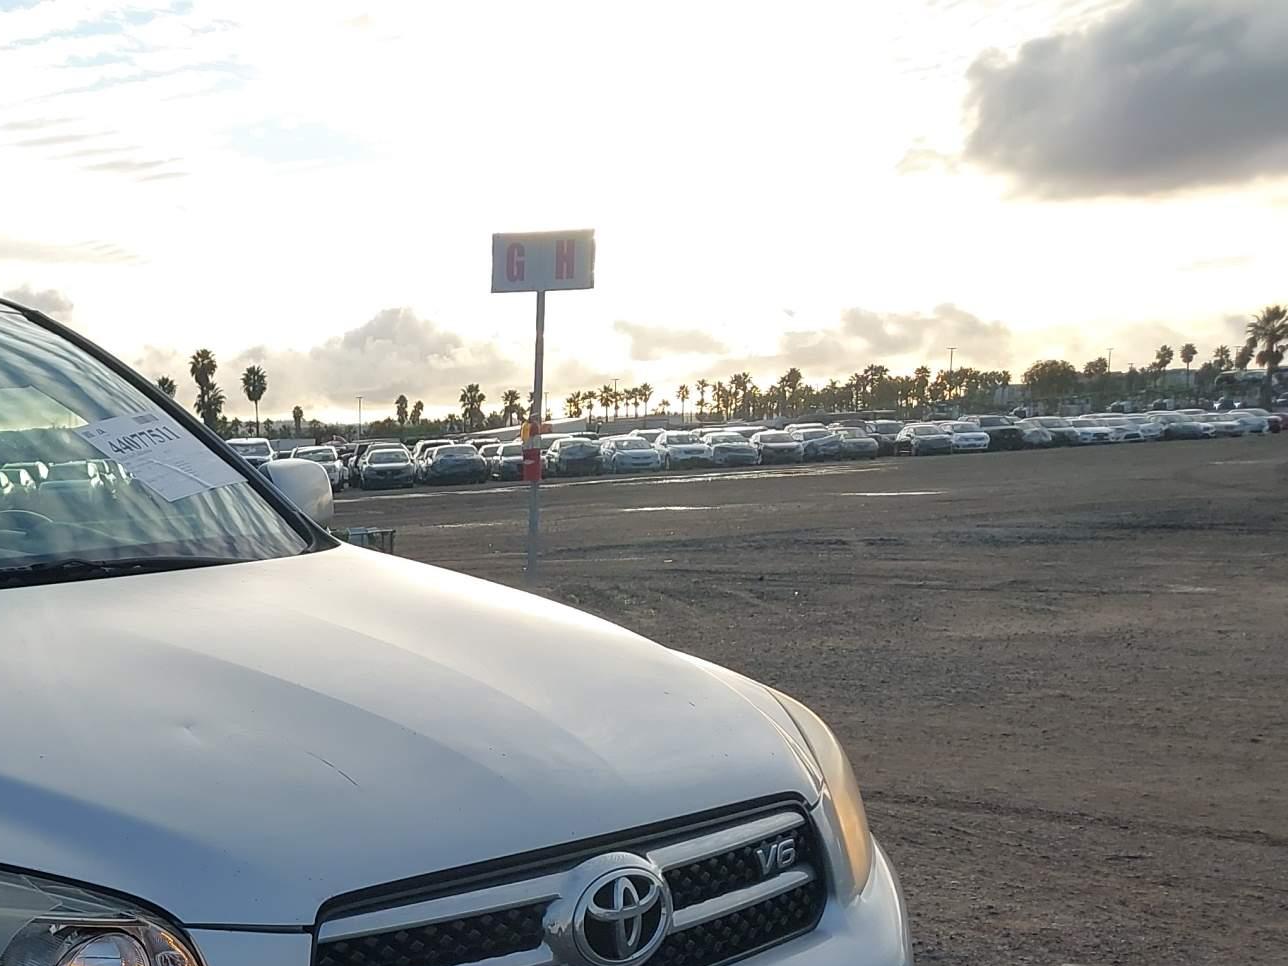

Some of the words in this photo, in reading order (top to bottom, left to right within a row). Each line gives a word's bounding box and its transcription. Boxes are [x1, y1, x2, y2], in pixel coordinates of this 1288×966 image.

[506, 242, 525, 282] G
[555, 239, 575, 280] H
[107, 426, 181, 455] 44077511
[756, 838, 796, 875] V6
